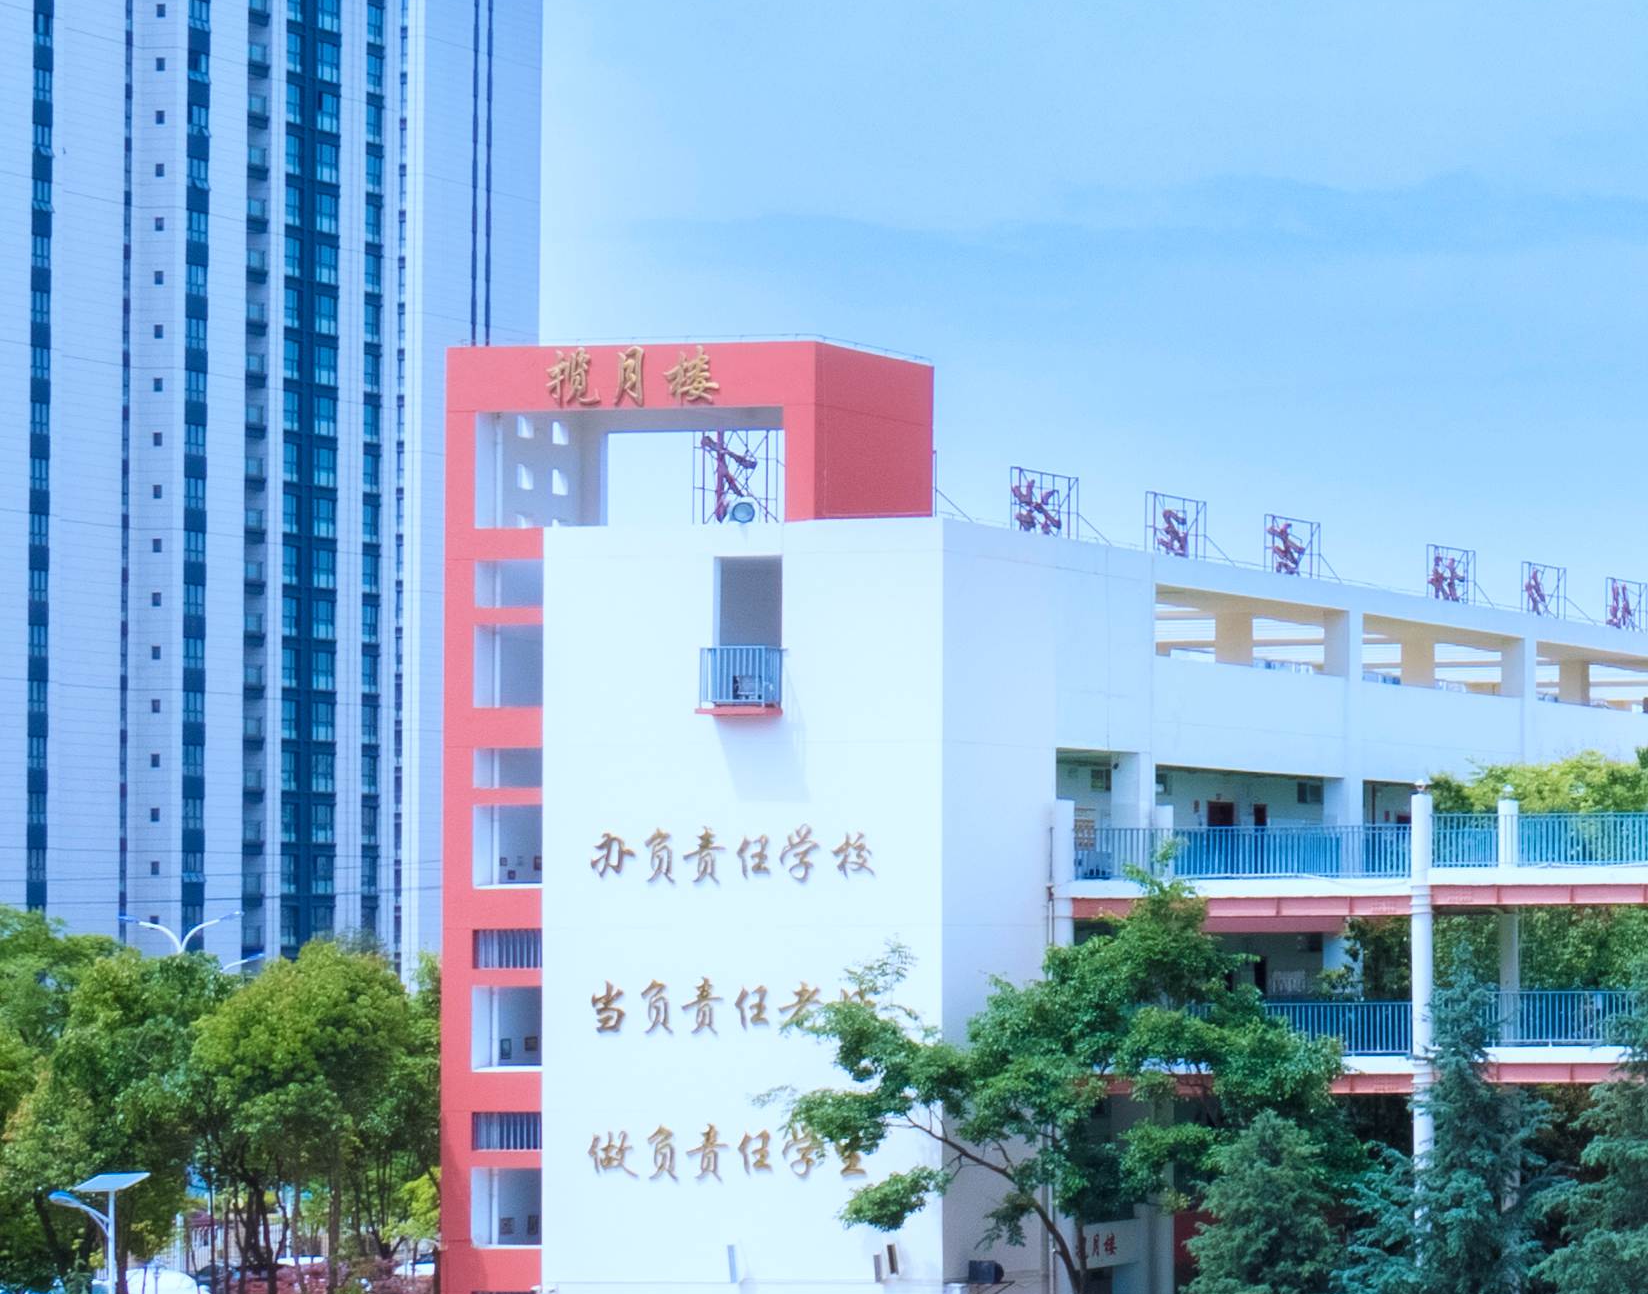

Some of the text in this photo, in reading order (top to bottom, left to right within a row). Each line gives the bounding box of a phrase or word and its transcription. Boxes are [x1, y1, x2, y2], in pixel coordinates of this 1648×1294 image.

[545, 345, 720, 407] 揽月楼
[590, 824, 877, 884] 办负责任学校
